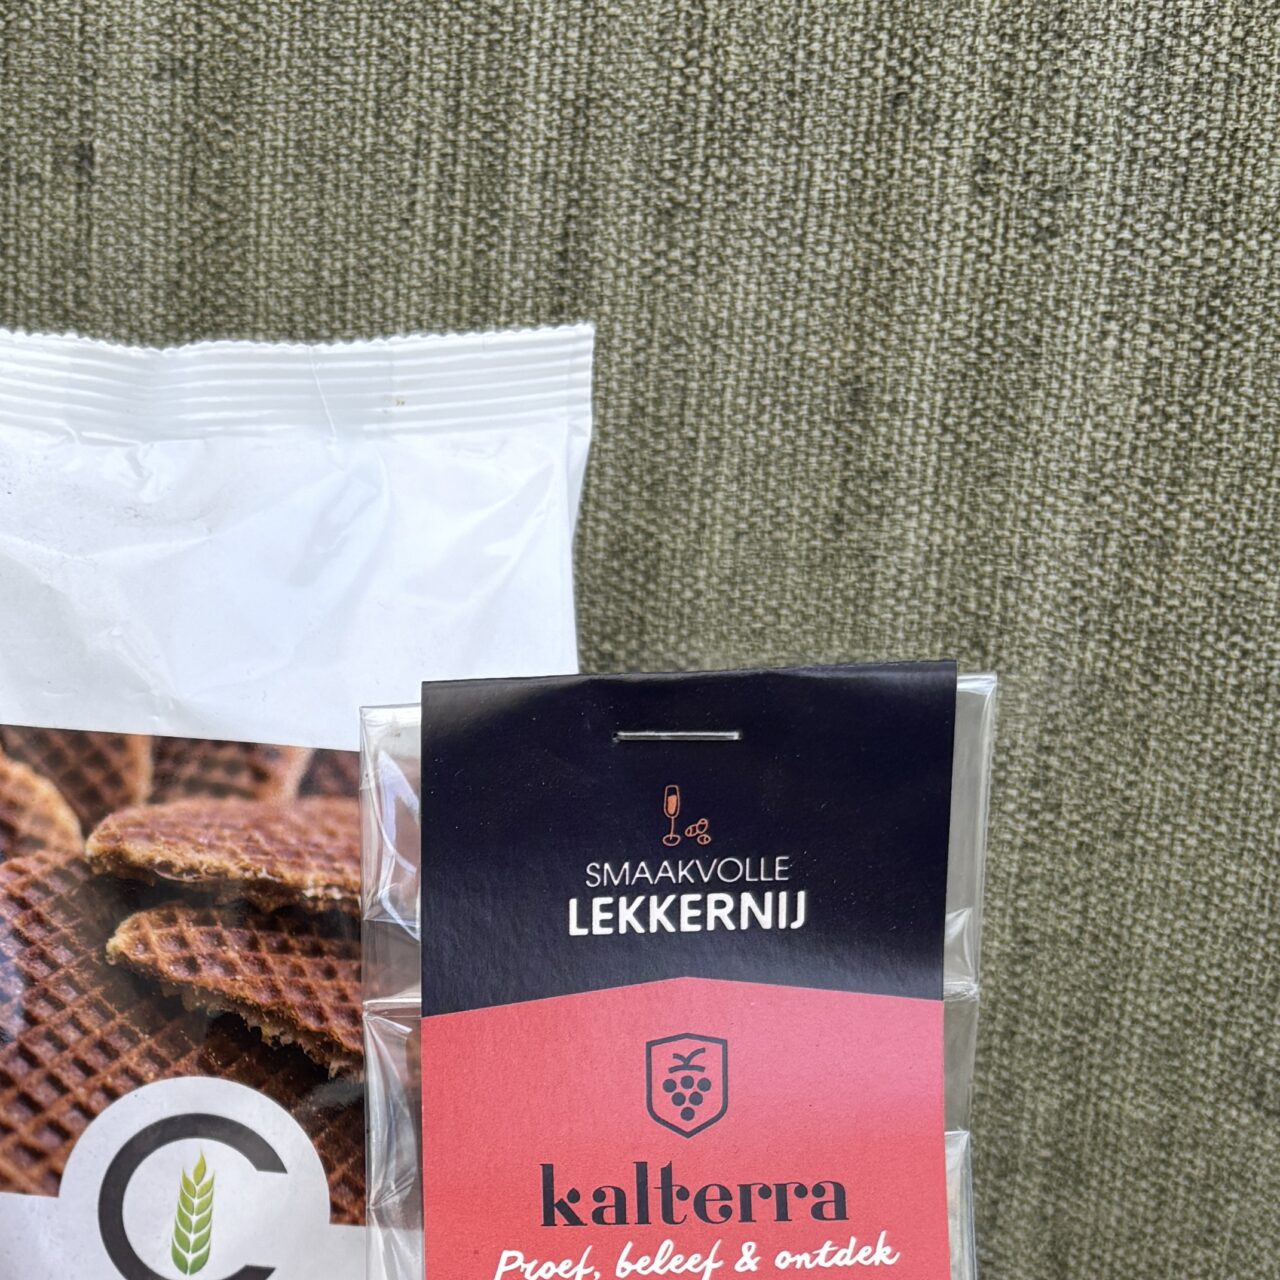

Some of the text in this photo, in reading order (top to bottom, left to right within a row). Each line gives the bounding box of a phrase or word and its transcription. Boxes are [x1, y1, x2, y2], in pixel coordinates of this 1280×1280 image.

[586, 856, 790, 889] SMAAKVOLLE
[568, 890, 806, 936] LEKKERNIJ
[539, 1161, 849, 1227] kalterra
[734, 1241, 760, 1272] &
[776, 1230, 901, 1270] ontdek
